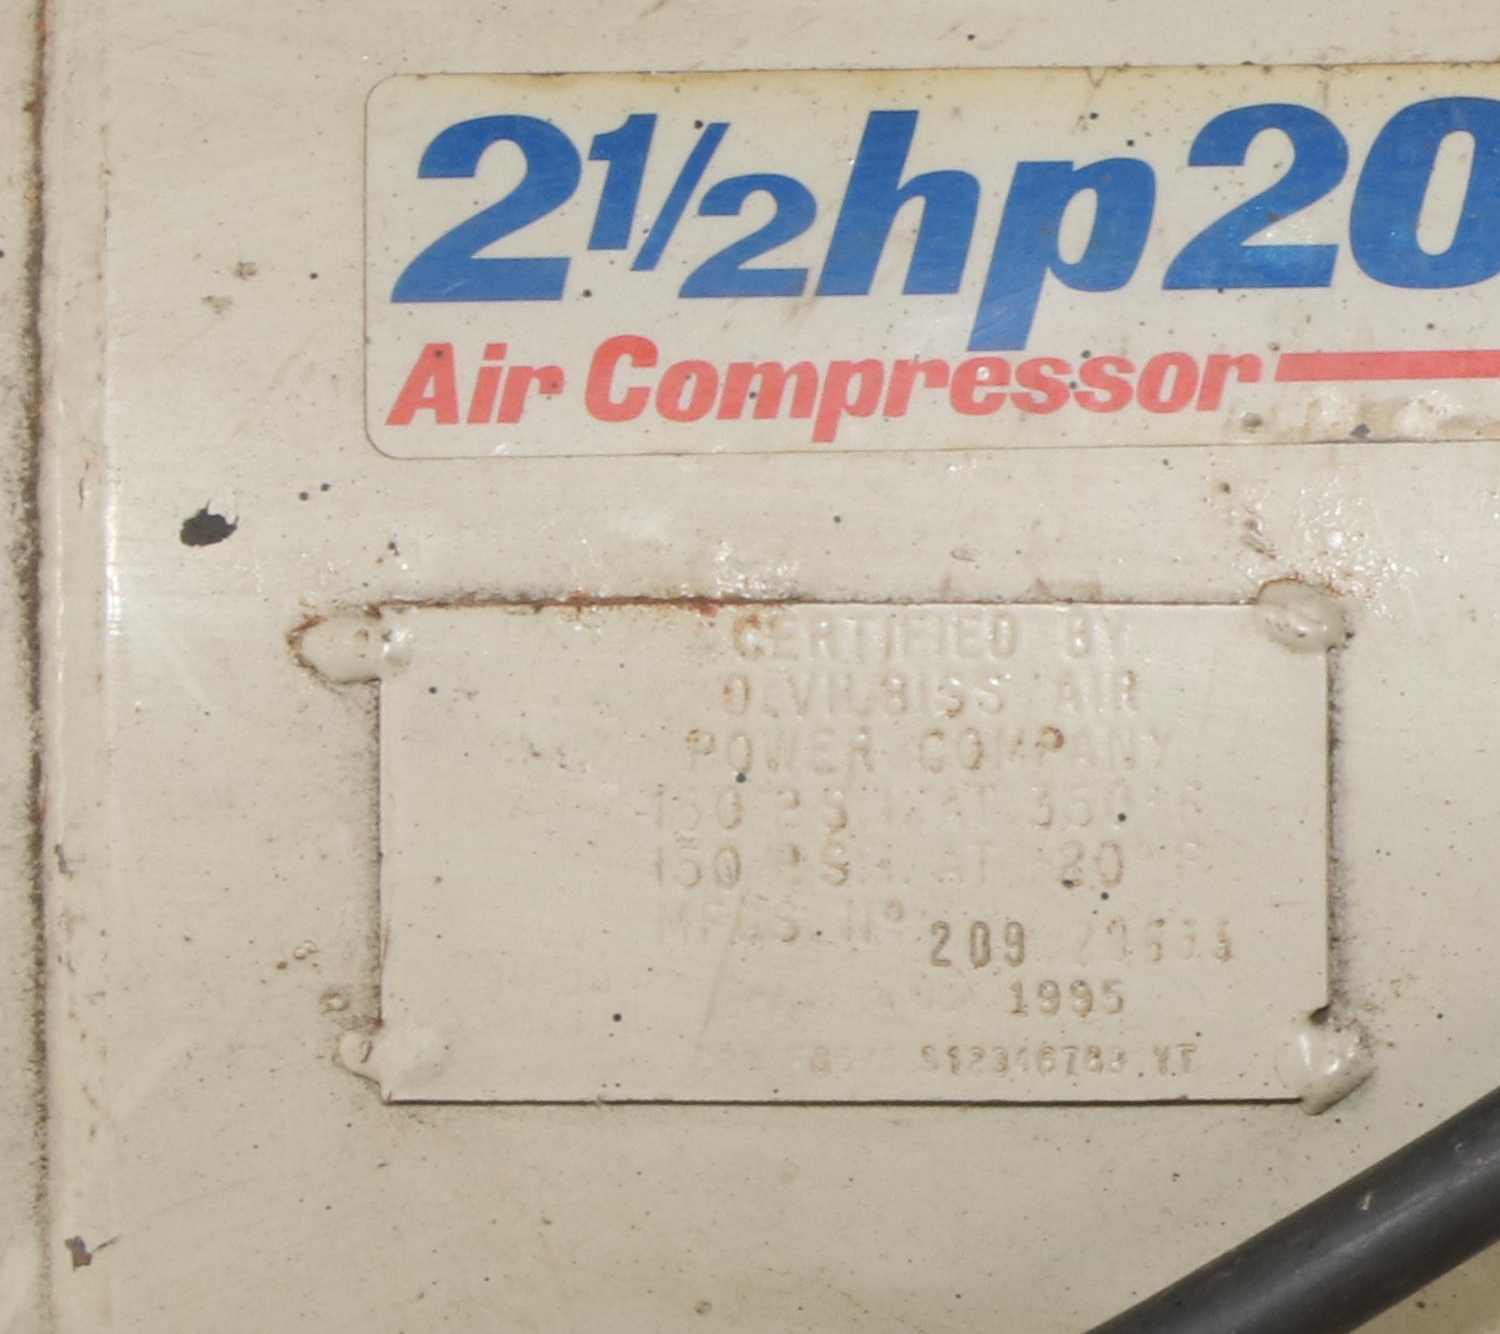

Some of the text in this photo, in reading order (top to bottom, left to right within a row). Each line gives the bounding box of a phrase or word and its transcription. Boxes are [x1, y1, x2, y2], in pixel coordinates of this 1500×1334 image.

[387, 334, 1264, 444] Air Compressor
[730, 612, 1130, 662] CERTIFIED BY
[1055, 668, 1140, 714] AIR
[685, 725, 1175, 776] POWER COMPANY
[928, 919, 1028, 970] 209
[1007, 978, 1127, 1018] 1995
